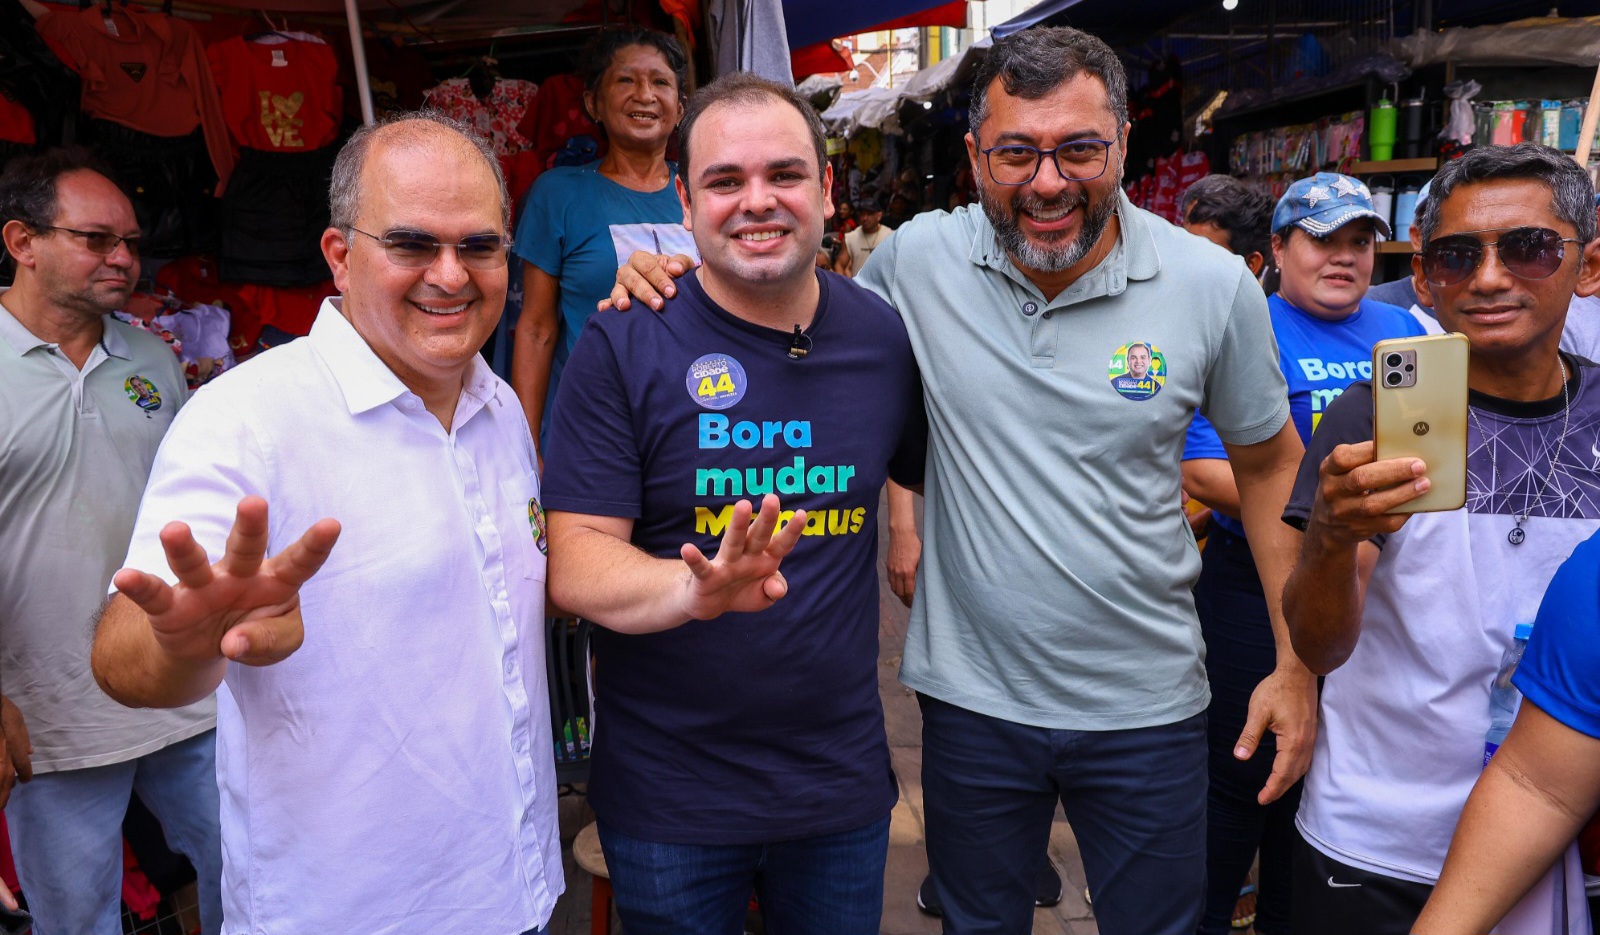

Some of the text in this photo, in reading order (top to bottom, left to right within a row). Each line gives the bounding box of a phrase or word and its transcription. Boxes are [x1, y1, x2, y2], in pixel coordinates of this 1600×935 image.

[1298, 358, 1373, 382] Bora
[697, 373, 736, 397] 44
[1138, 380, 1151, 389] 44
[698, 413, 812, 449] Bora
[695, 456, 855, 496] mudar
